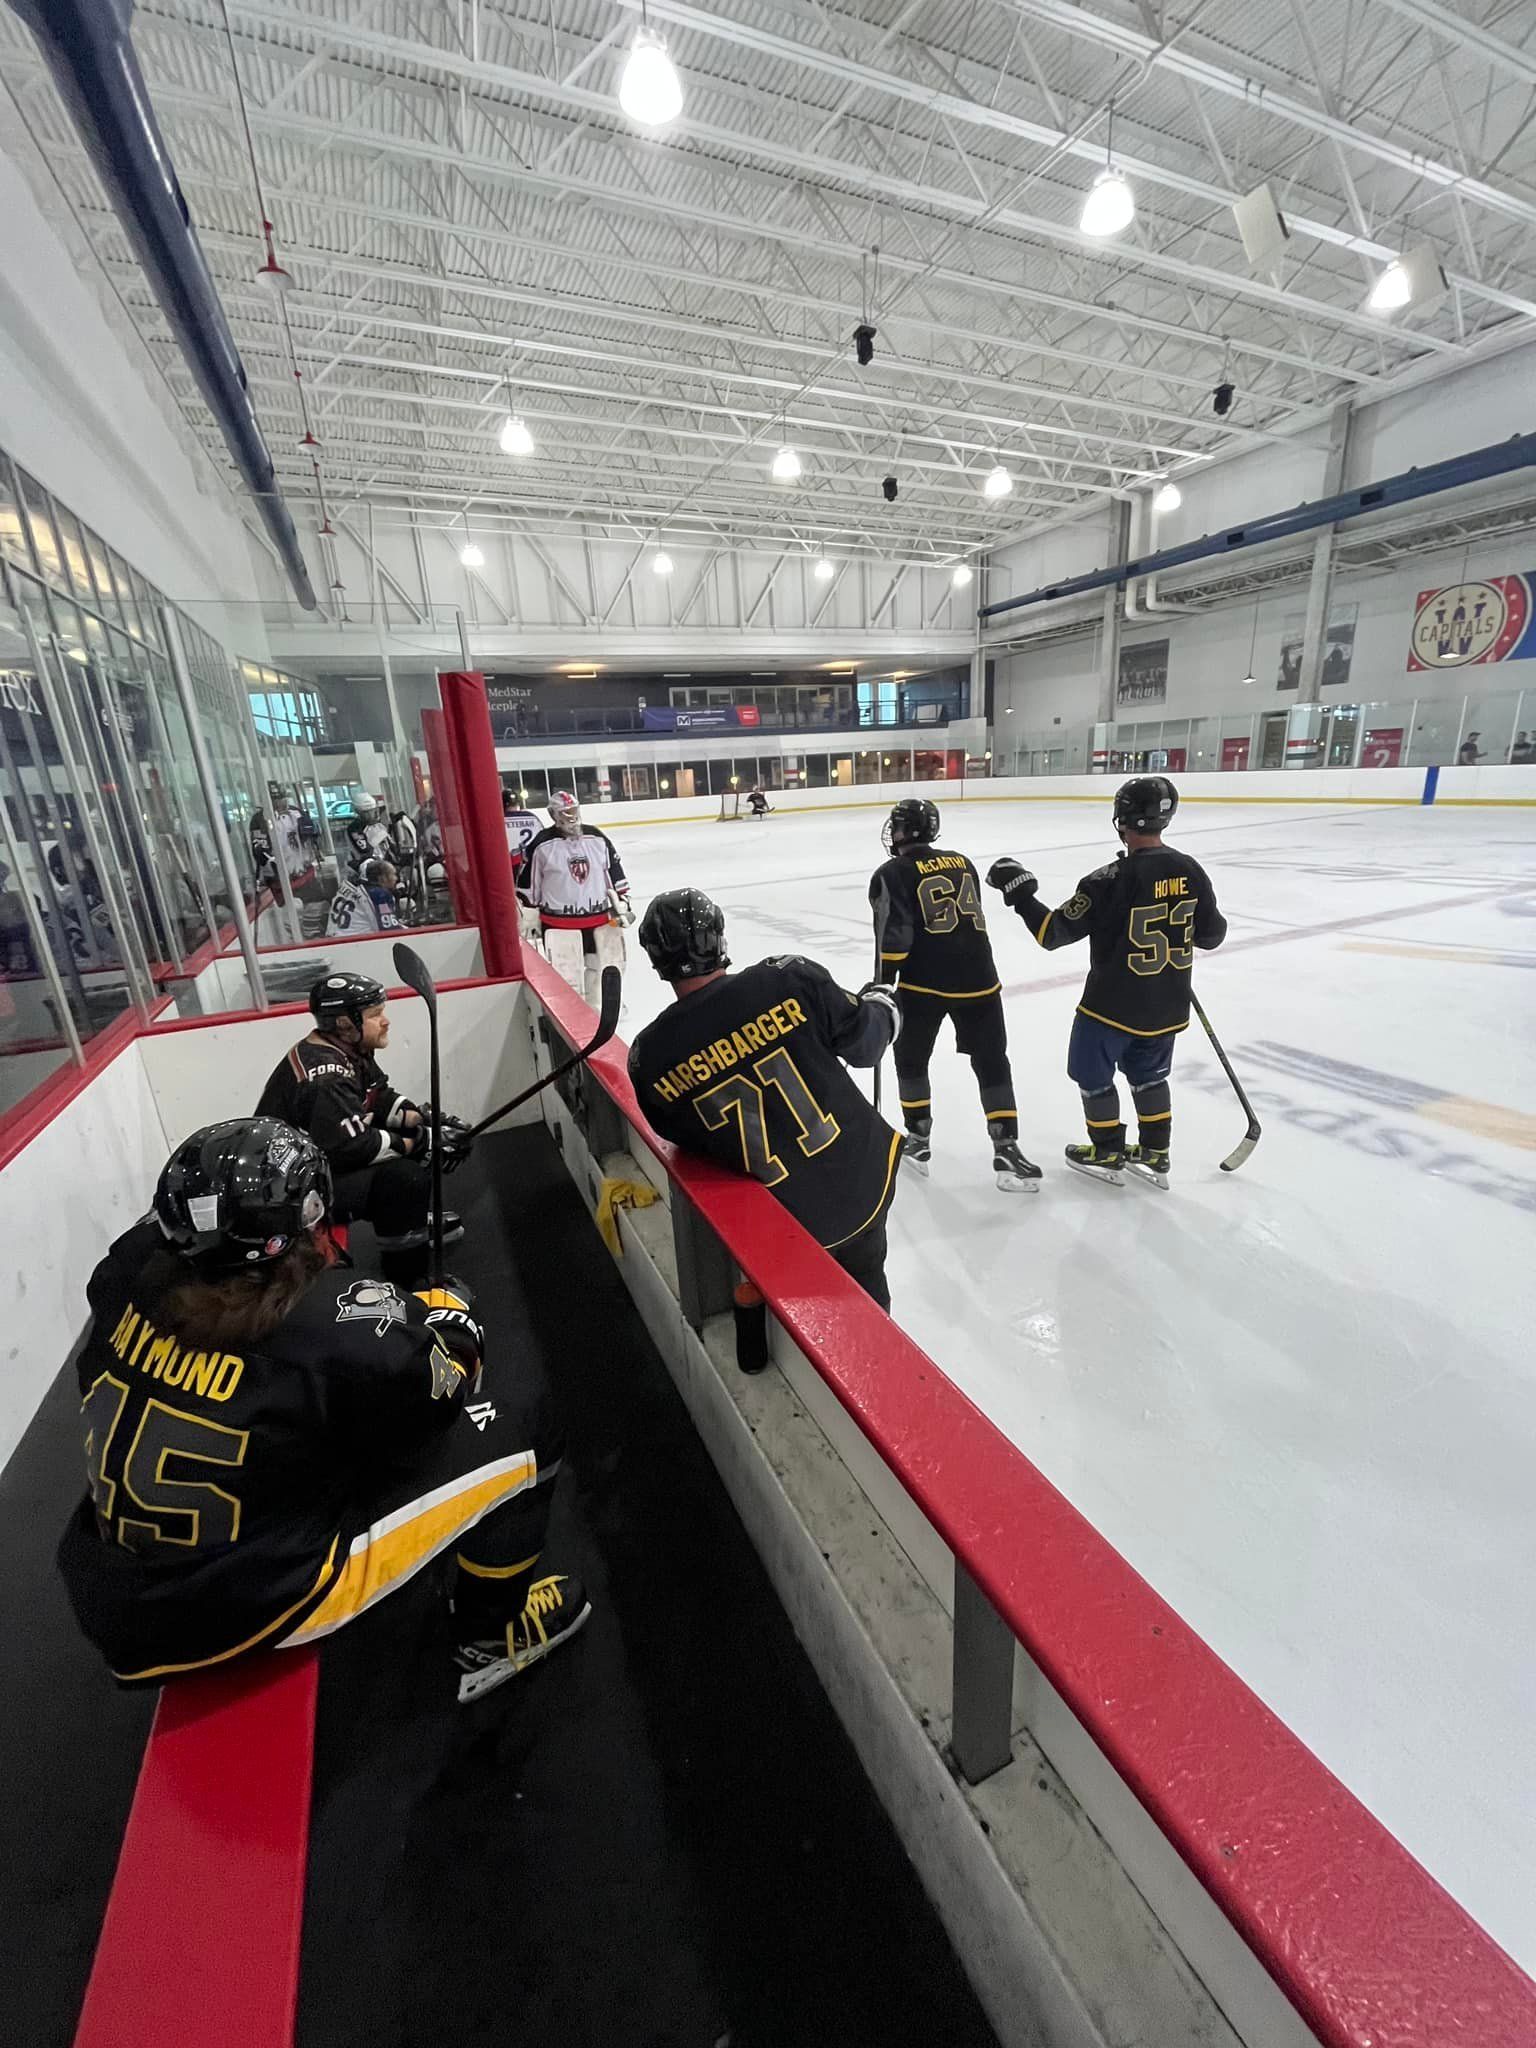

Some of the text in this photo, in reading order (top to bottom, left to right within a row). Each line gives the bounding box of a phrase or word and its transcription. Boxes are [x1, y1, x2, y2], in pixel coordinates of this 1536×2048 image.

[1420, 616, 1495, 643] CAPITALS
[488, 686, 532, 697] MedStar
[917, 872, 986, 934] 64
[1155, 877, 1188, 898] HOWE
[381, 914, 398, 928] 96
[1128, 899, 1198, 975] 53
[653, 998, 807, 1102] HARSHBARGER
[693, 1046, 841, 1187] 71
